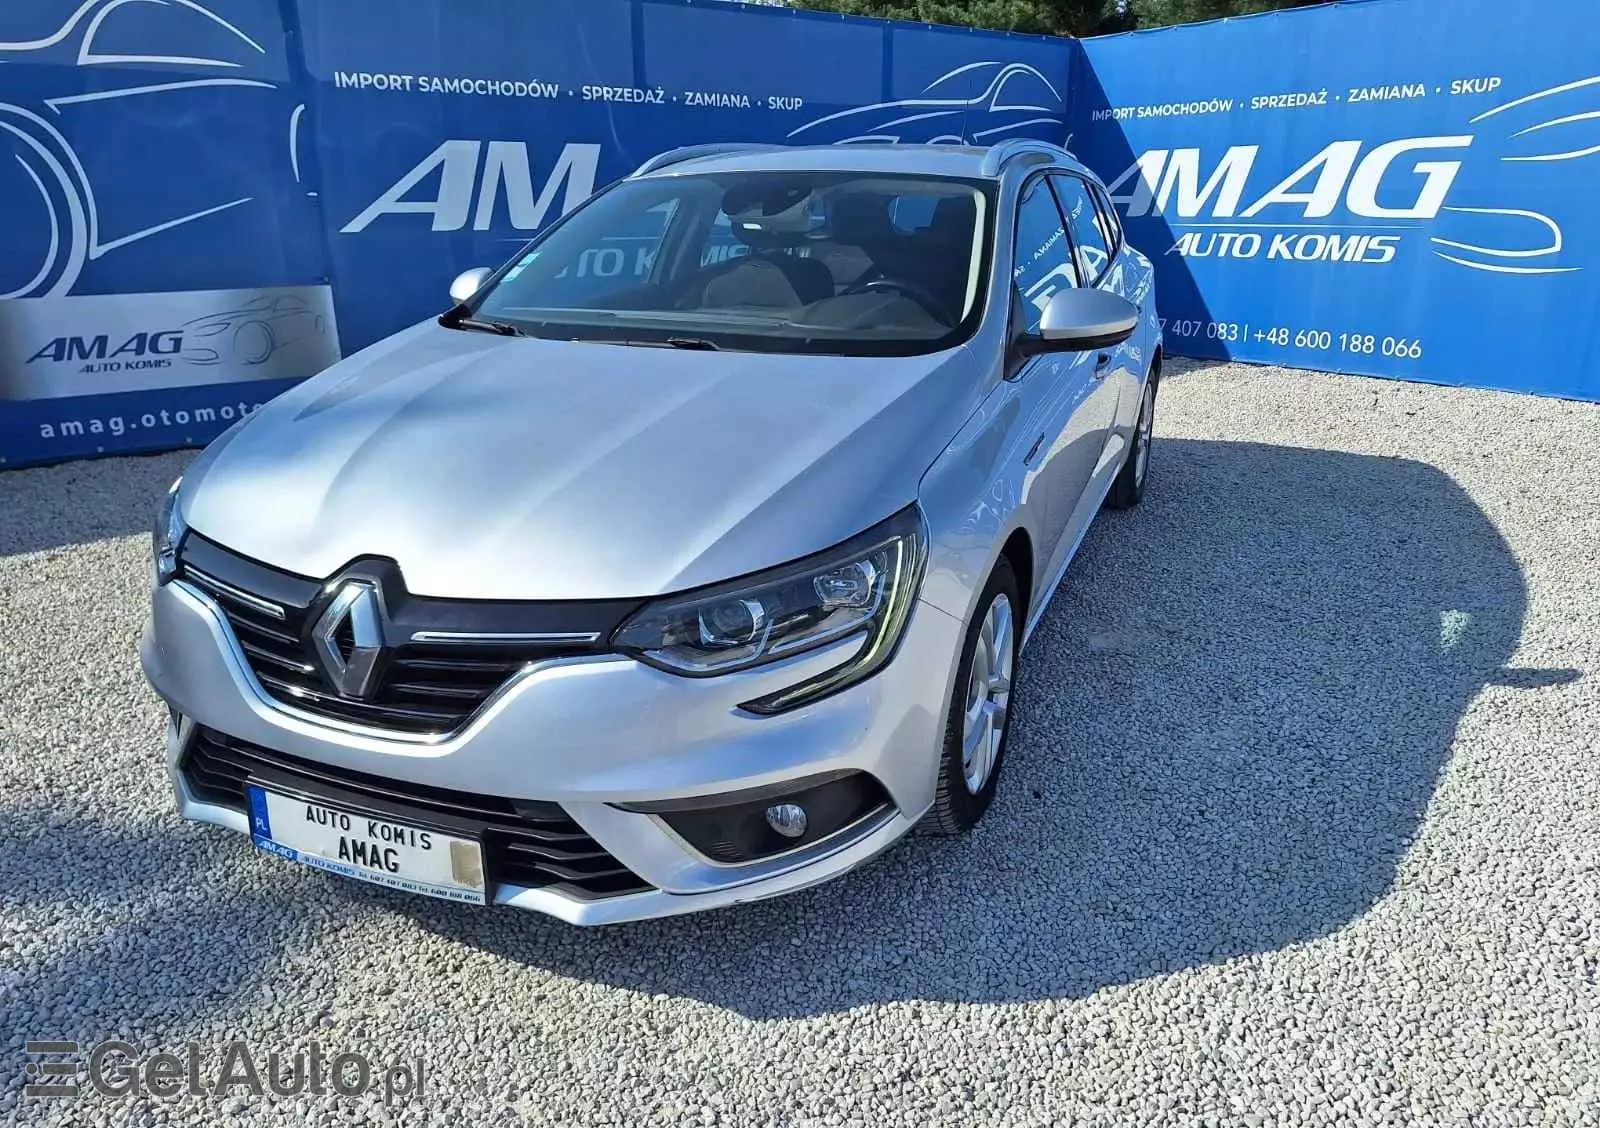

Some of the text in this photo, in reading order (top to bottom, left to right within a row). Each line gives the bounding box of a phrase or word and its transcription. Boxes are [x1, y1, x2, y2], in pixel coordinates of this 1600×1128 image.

[334, 71, 803, 111] IMPORT SAMOCHODÓW SPRZEDAŻ ZAMIANA SKUP
[1092, 77, 1502, 122] IMPORT SAMOCHODÓW SPRZEDAŻ ZAMIANA SKUP
[1164, 232, 1402, 264] AUTO KOMIS
[1171, 319, 1202, 338] 407
[1206, 321, 1238, 342] 083
[1253, 327, 1290, 347] +48
[1294, 328, 1332, 350] 600
[1338, 332, 1376, 354] 188
[1381, 336, 1423, 359] 066
[79, 358, 172, 374] AUTO KOMIS
[255, 817, 267, 831] PL
[306, 805, 432, 850] AUTO KOMIS
[338, 836, 400, 874] AMAG
